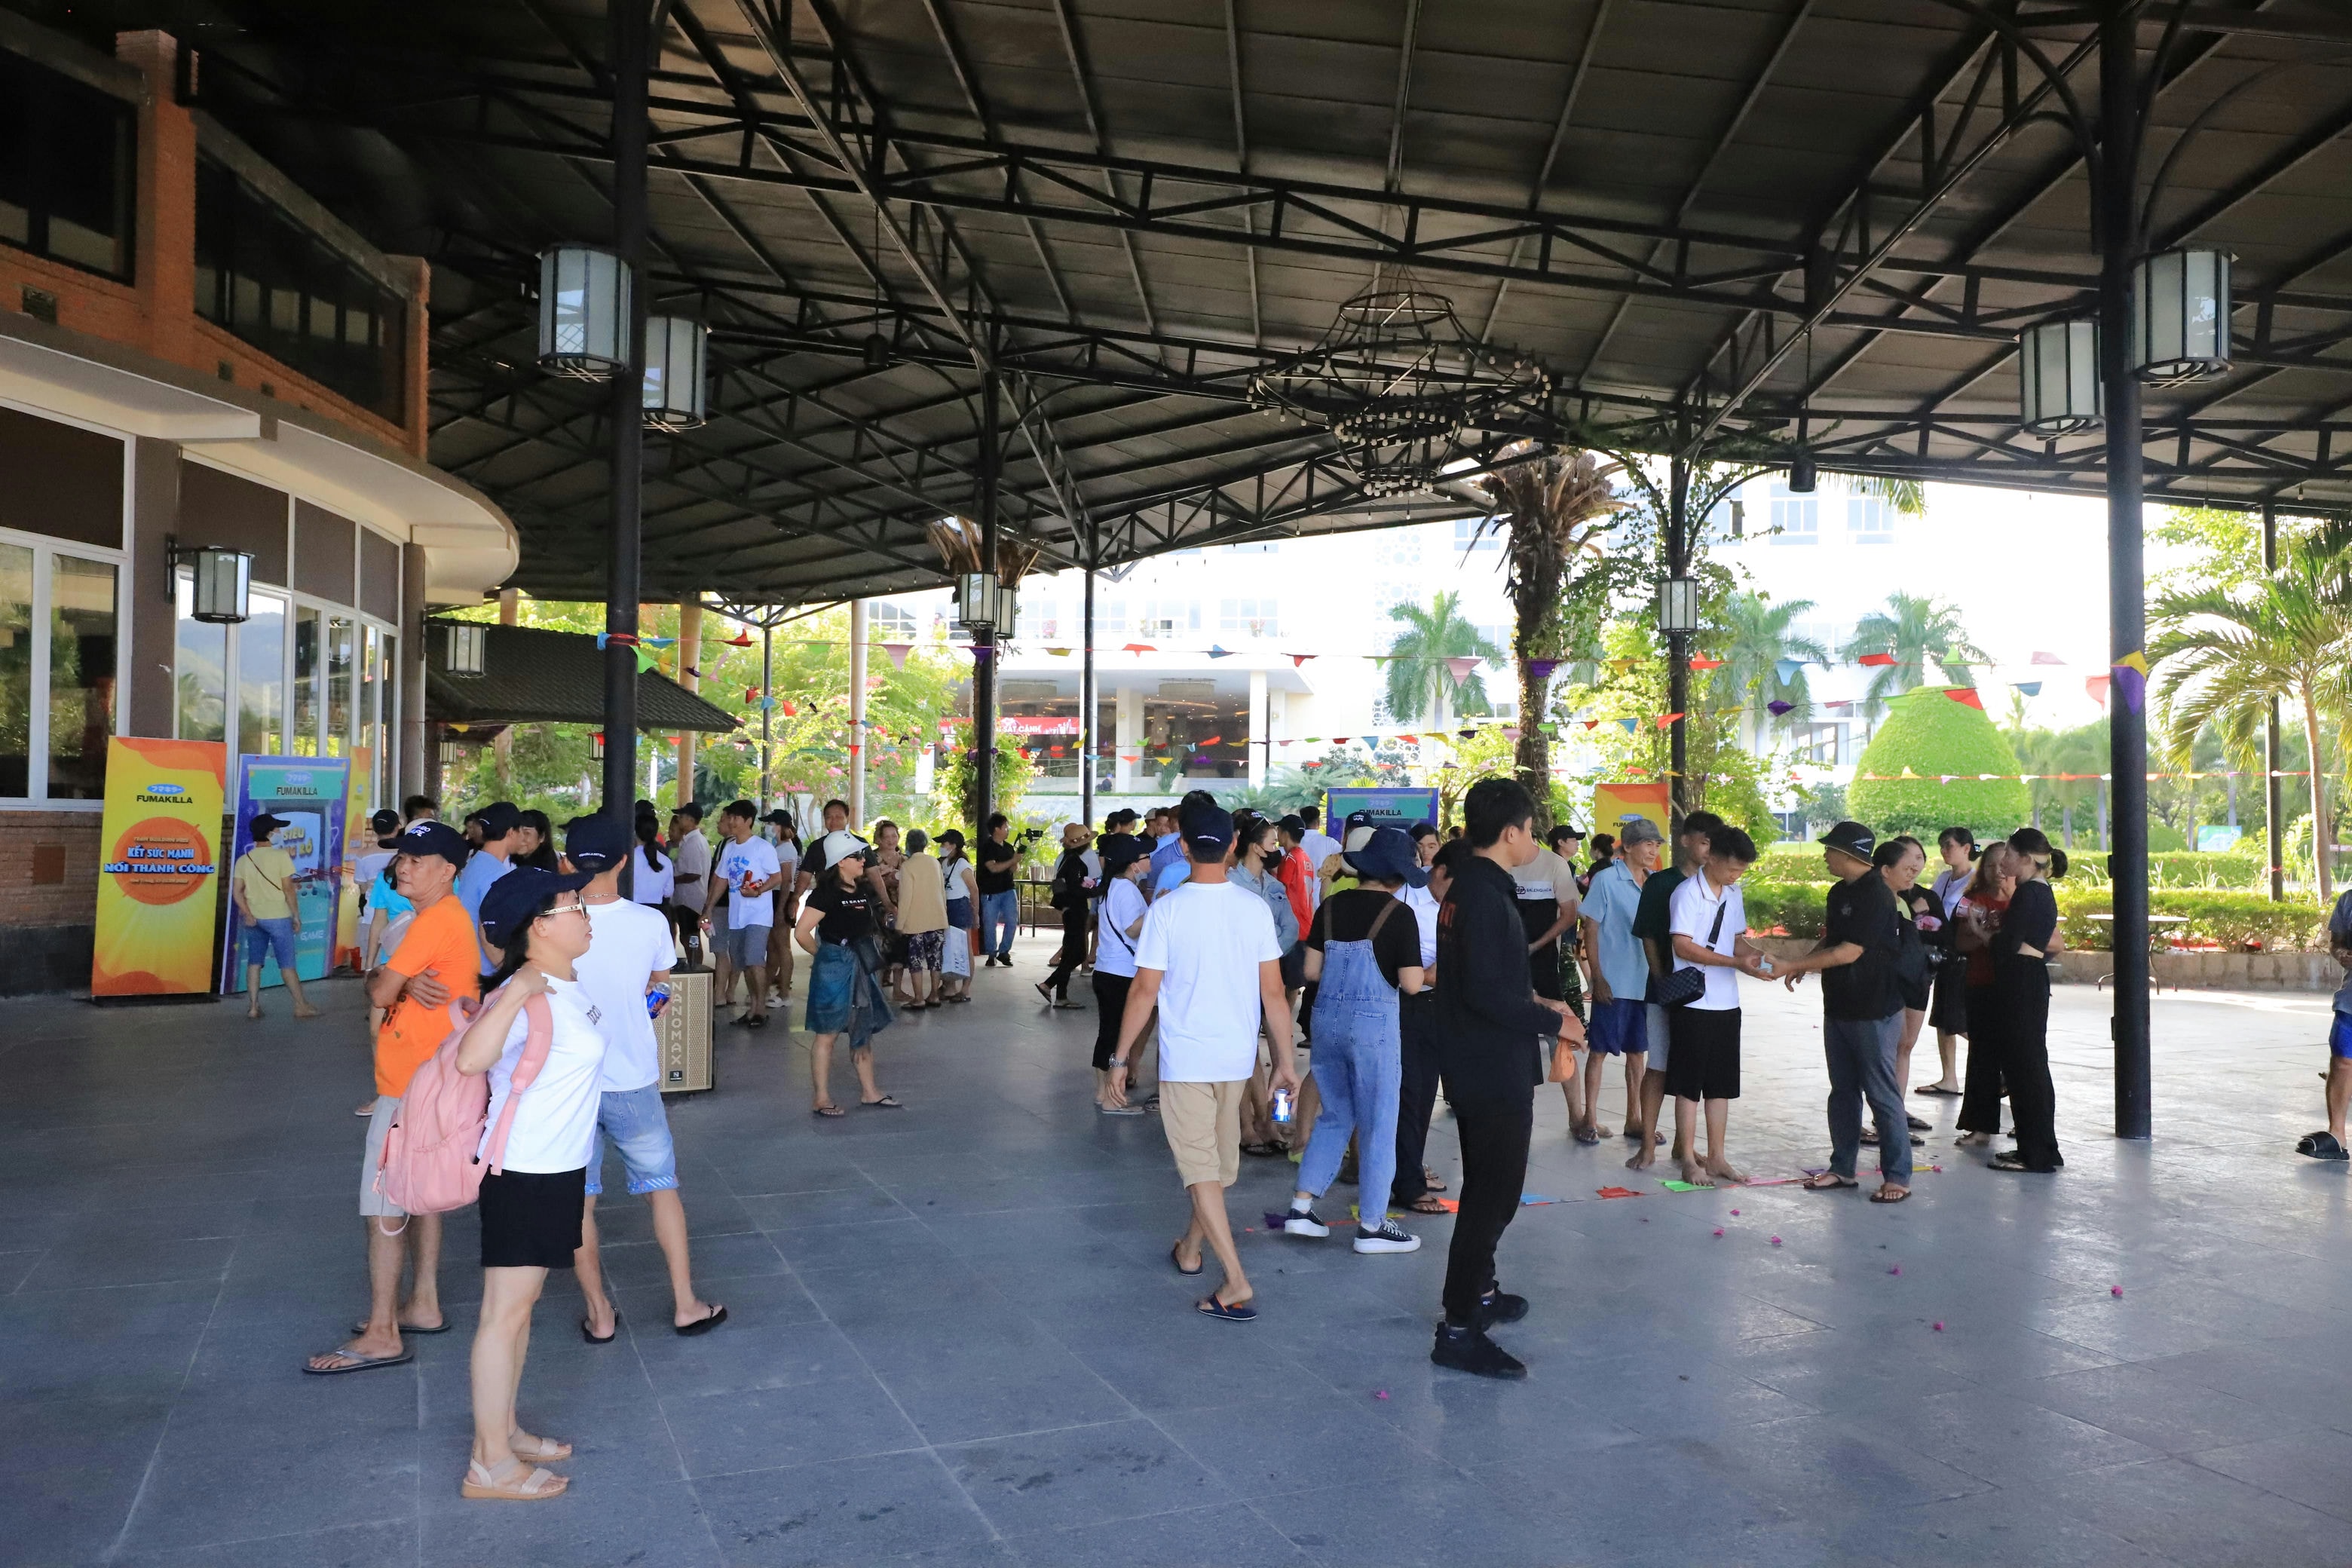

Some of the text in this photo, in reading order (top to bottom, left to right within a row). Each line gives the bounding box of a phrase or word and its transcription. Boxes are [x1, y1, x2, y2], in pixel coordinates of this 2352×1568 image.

[276, 786, 318, 796] FUMAKILLA
[136, 795, 193, 804] FUMAKILLA
[127, 845, 194, 860] KẾT SỨC MẠNH
[104, 861, 215, 874] NỐI THÀNH CÔNG
[301, 929, 324, 942] GAME
[671, 982, 682, 1065] NANOMAX
